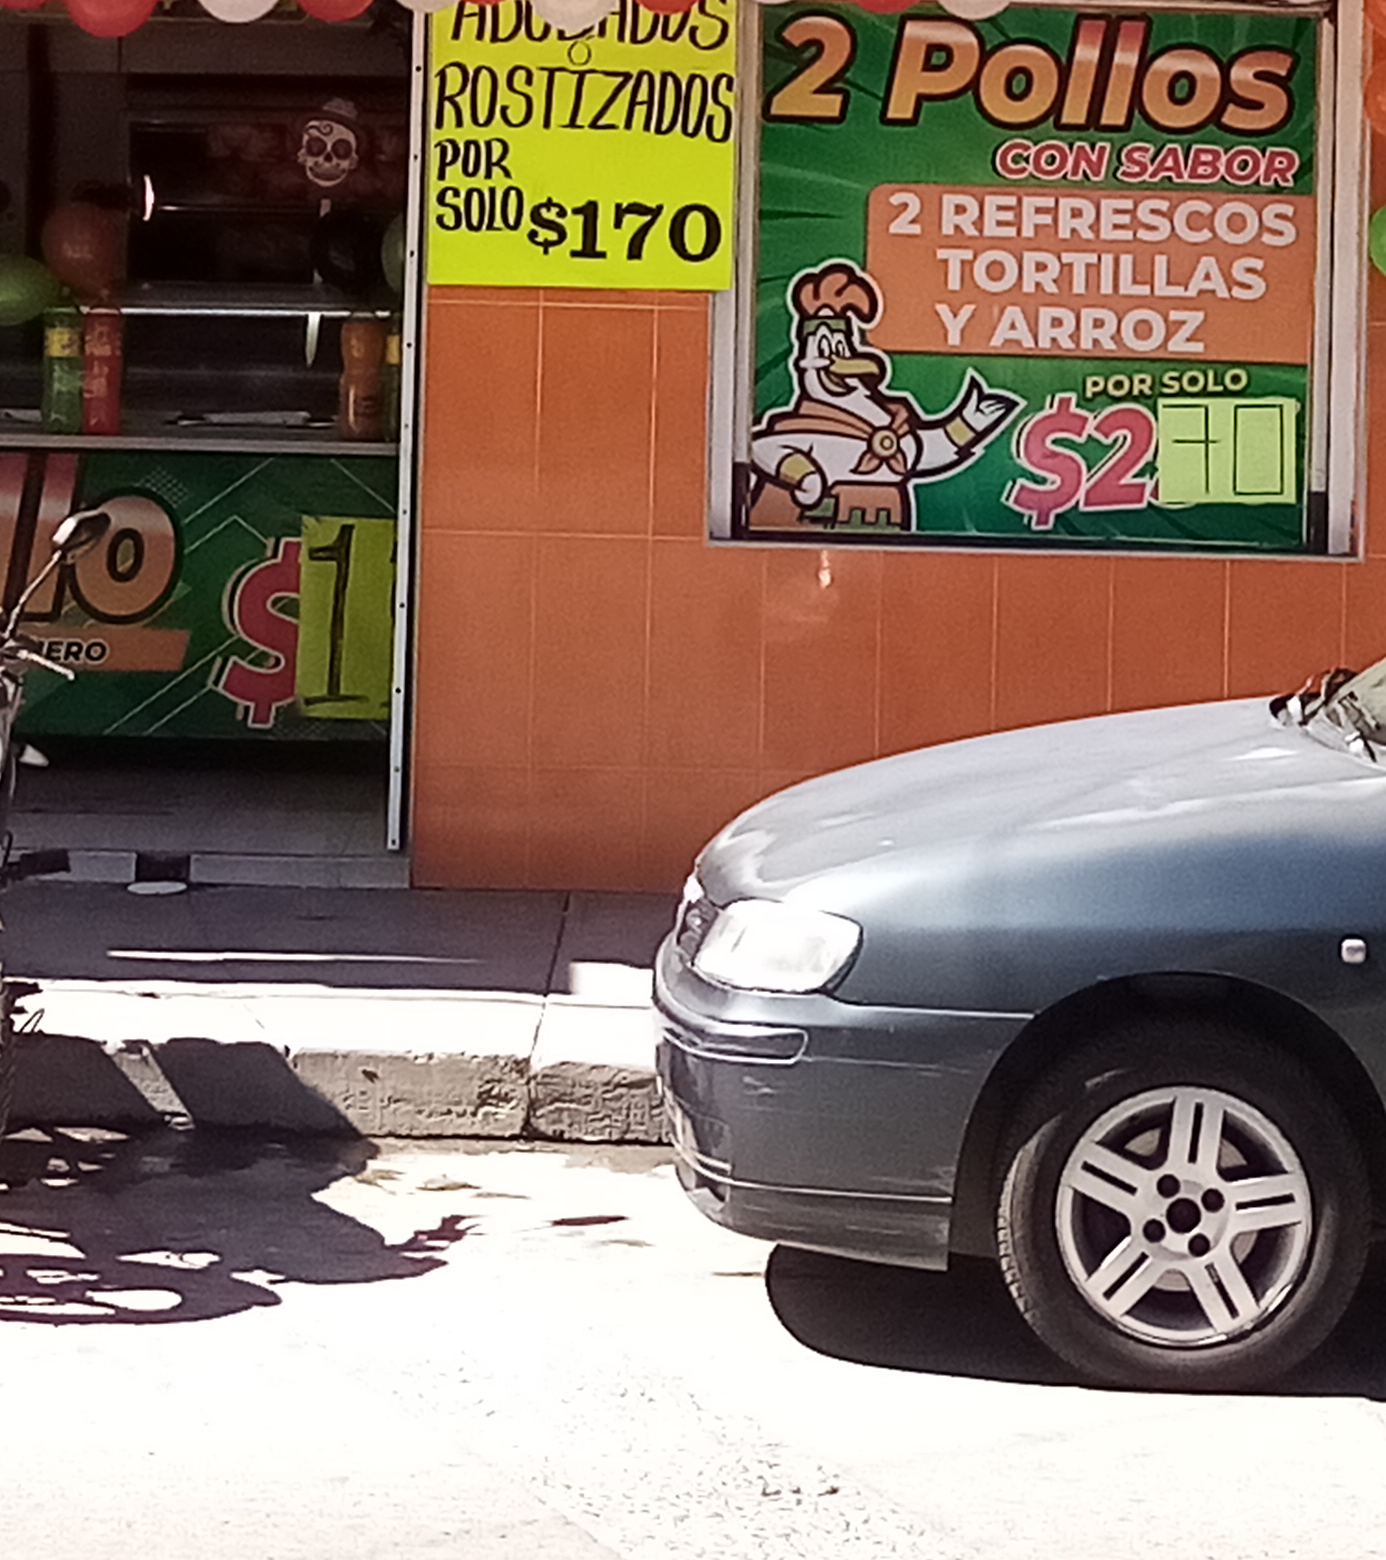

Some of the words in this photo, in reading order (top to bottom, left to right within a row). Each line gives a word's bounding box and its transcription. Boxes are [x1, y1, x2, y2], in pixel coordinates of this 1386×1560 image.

[767, 15, 855, 121] 2
[883, 13, 1297, 132] Pollos
[434, 61, 734, 143] ROSTIZADOS
[434, 137, 513, 181] POR
[996, 141, 1109, 182] CON
[1120, 144, 1299, 186] SABOR
[435, 185, 524, 232] SOLO
[527, 197, 723, 263] $170
[888, 194, 922, 236] 2
[940, 195, 1297, 246] REFRESCOS
[937, 249, 1268, 300] TORTILLAS
[934, 304, 976, 347] Y
[990, 310, 1206, 354] ARROZ
[1085, 375, 1153, 397] POR
[1162, 368, 1249, 393] SOLO
